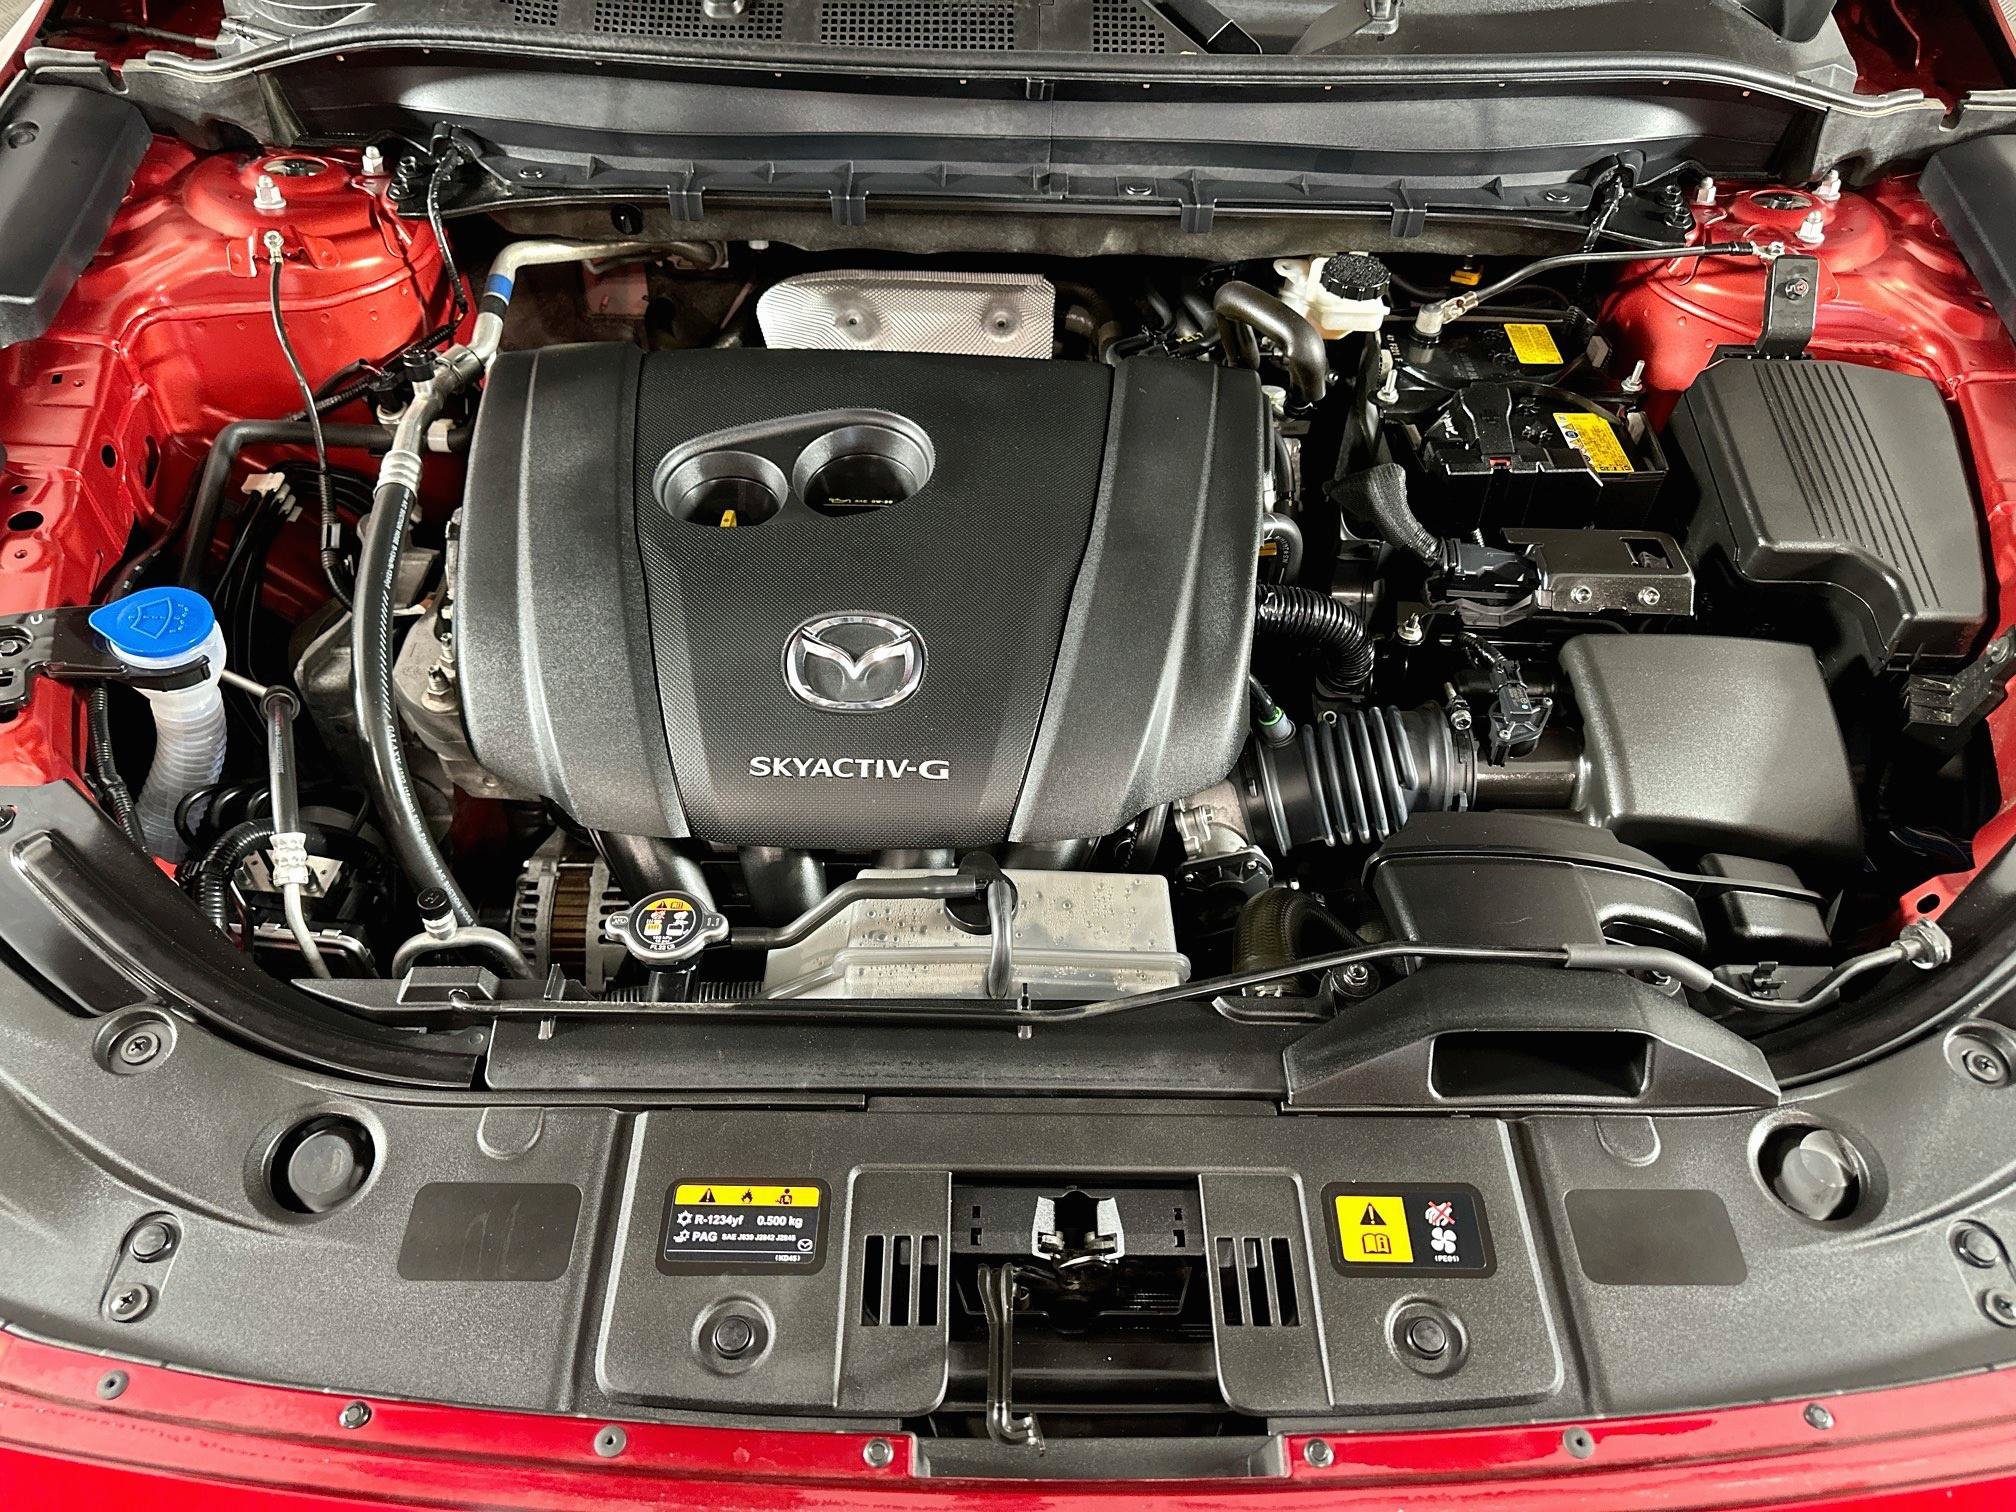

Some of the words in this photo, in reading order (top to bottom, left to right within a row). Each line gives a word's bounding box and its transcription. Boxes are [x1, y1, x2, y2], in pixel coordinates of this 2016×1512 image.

[749, 756, 950, 780] SKYACTIV-G
[437, 869, 447, 881] A/C
[443, 880, 462, 909] SUCTION
[460, 907, 474, 925] HOSE
[706, 917, 720, 927] 1.1
[694, 1214, 744, 1228] R-1234yf
[757, 1215, 787, 1226] 0.500
[788, 1215, 803, 1229] kg
[692, 1231, 718, 1242] PAG
[722, 1233, 736, 1241] SAE
